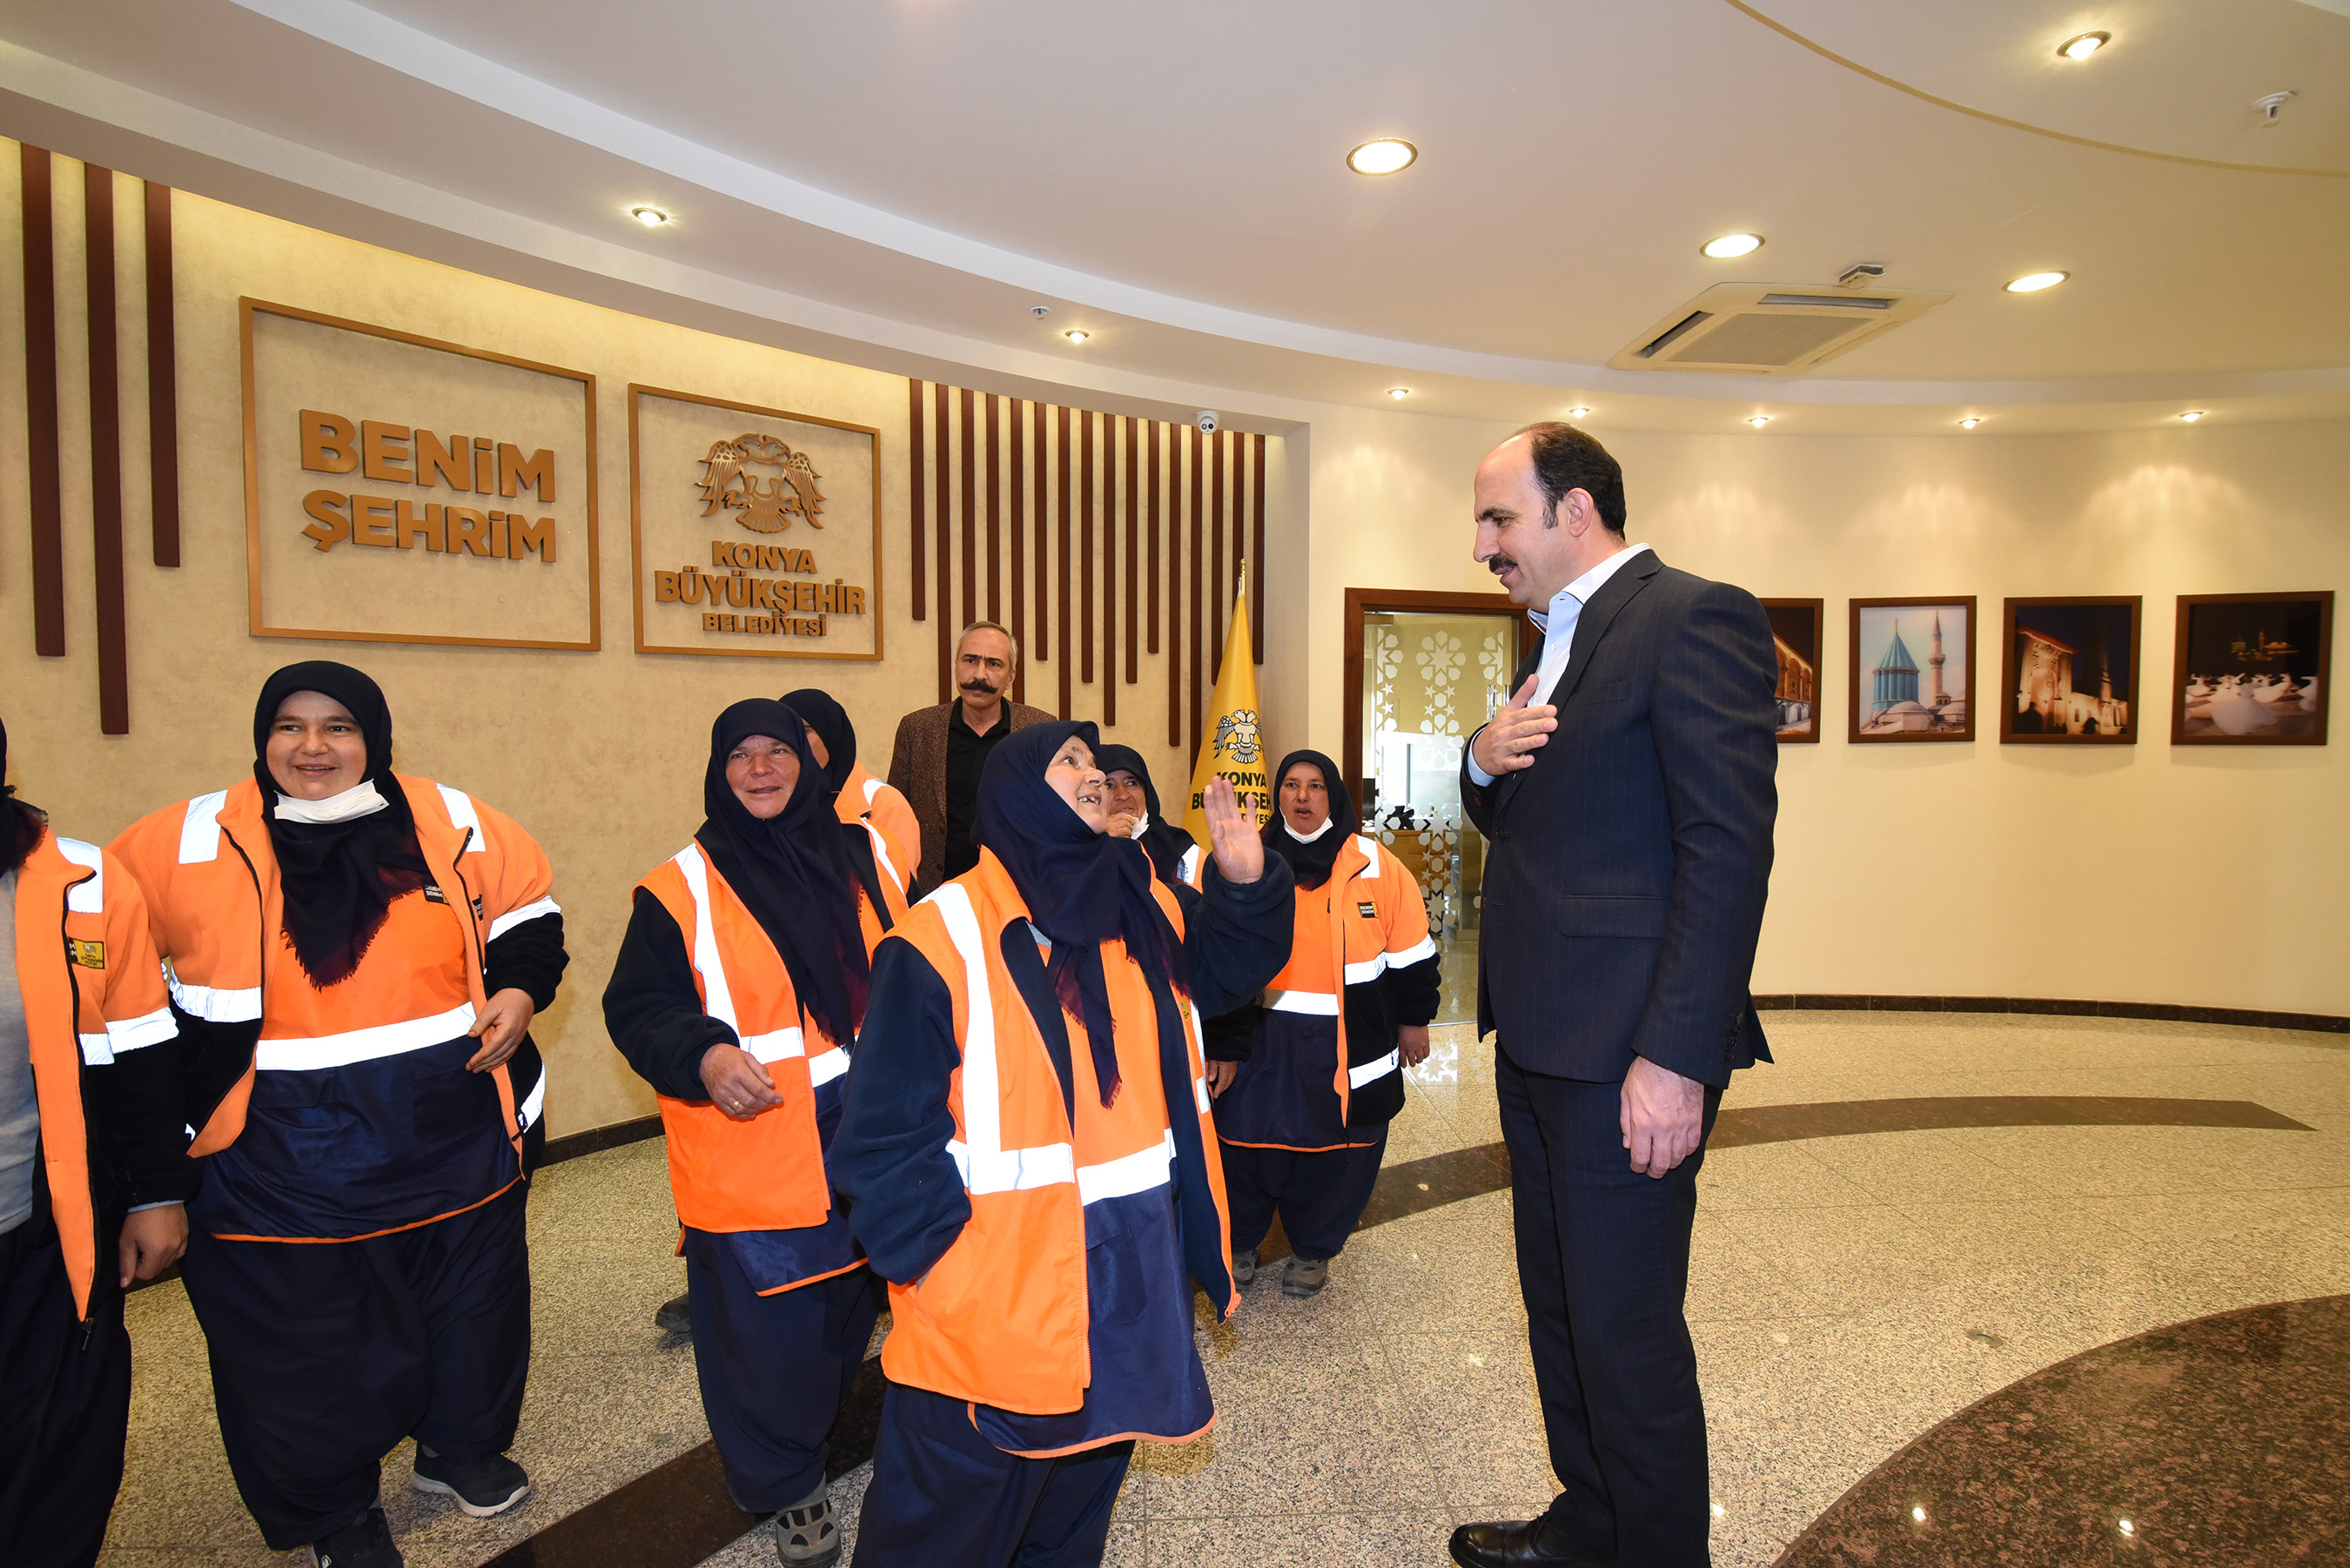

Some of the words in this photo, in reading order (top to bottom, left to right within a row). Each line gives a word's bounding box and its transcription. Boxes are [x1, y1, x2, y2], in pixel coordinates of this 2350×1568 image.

[712, 540, 817, 574] KONYA
[655, 566, 866, 616] BÜYÜKŞEHİR
[702, 610, 827, 636] BELEDİYESİ
